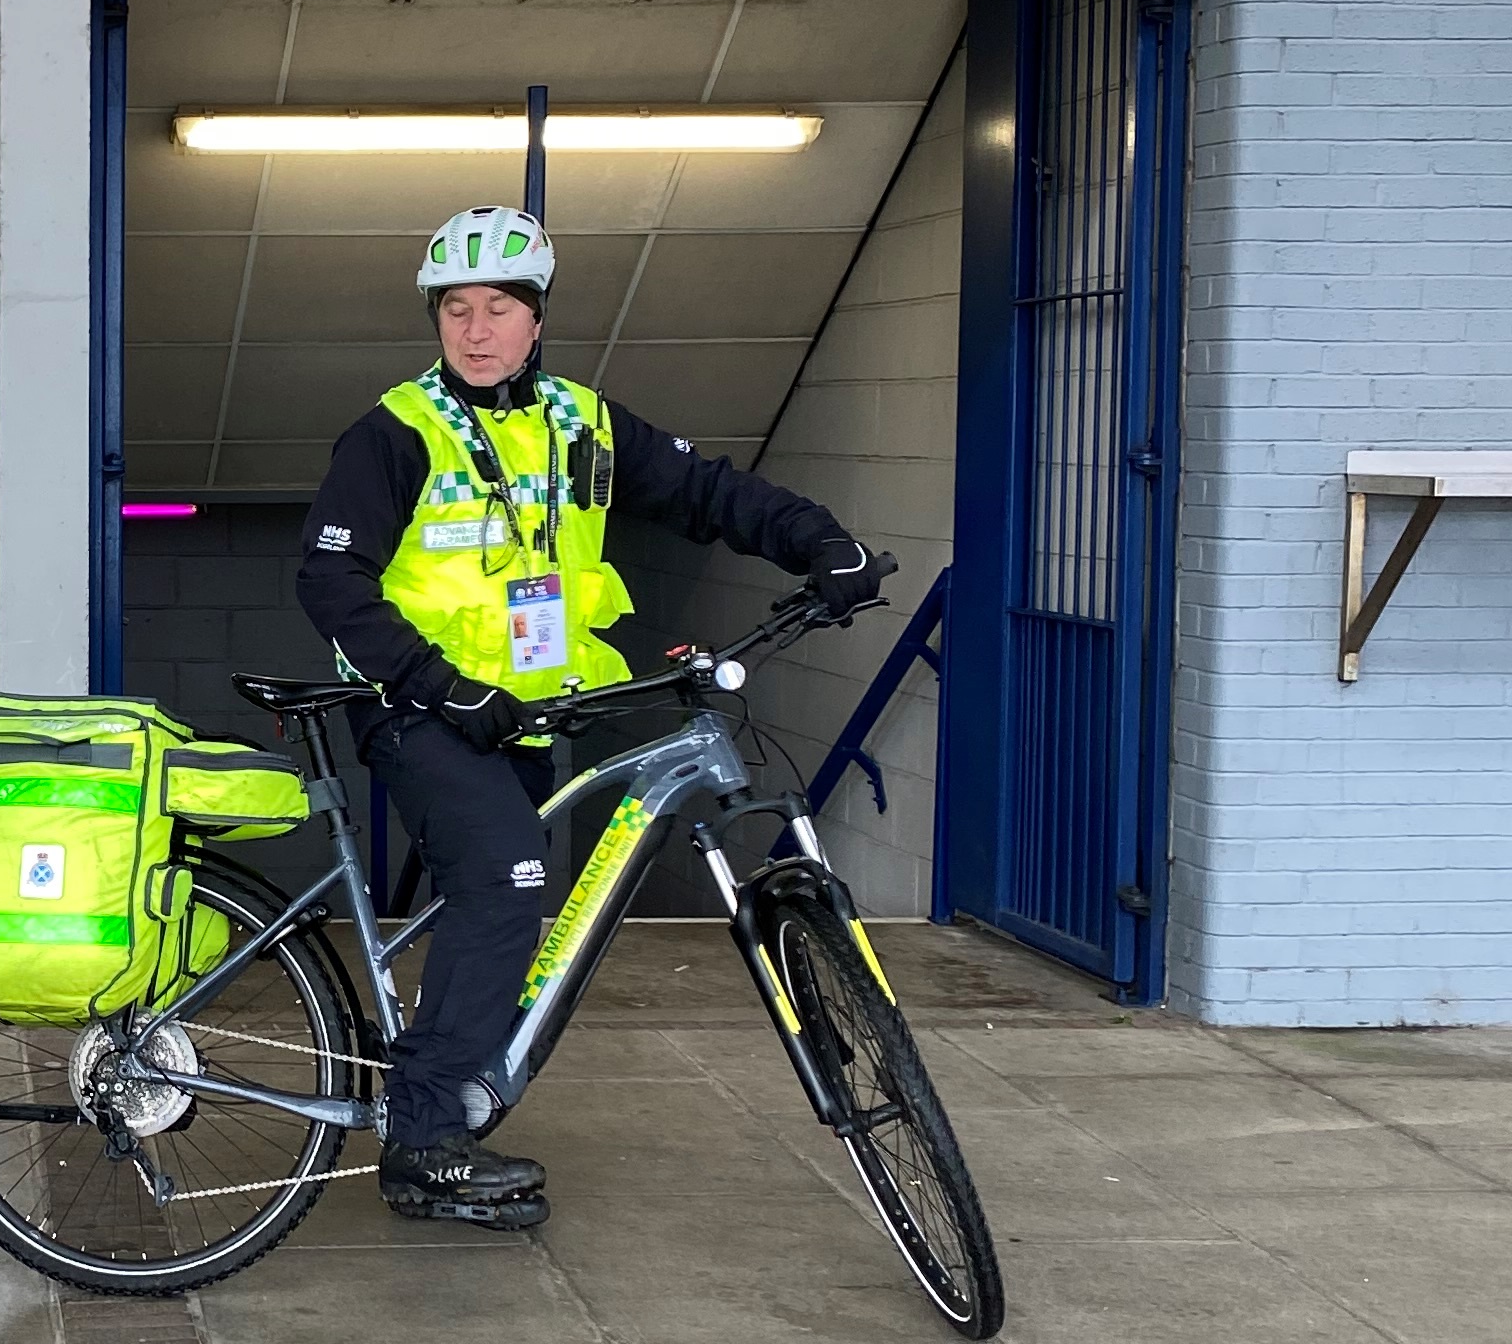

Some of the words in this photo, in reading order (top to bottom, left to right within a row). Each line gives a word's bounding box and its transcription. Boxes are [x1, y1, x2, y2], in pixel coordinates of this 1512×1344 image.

[322, 524, 352, 541] NHS
[513, 859, 544, 875] NHS
[538, 829, 621, 974] AMBULANCE
[562, 919, 588, 956] CYCLE
[582, 863, 621, 920] RESPONSE
[614, 836, 635, 863] UNIT
[437, 1165, 474, 1183] LAKE
